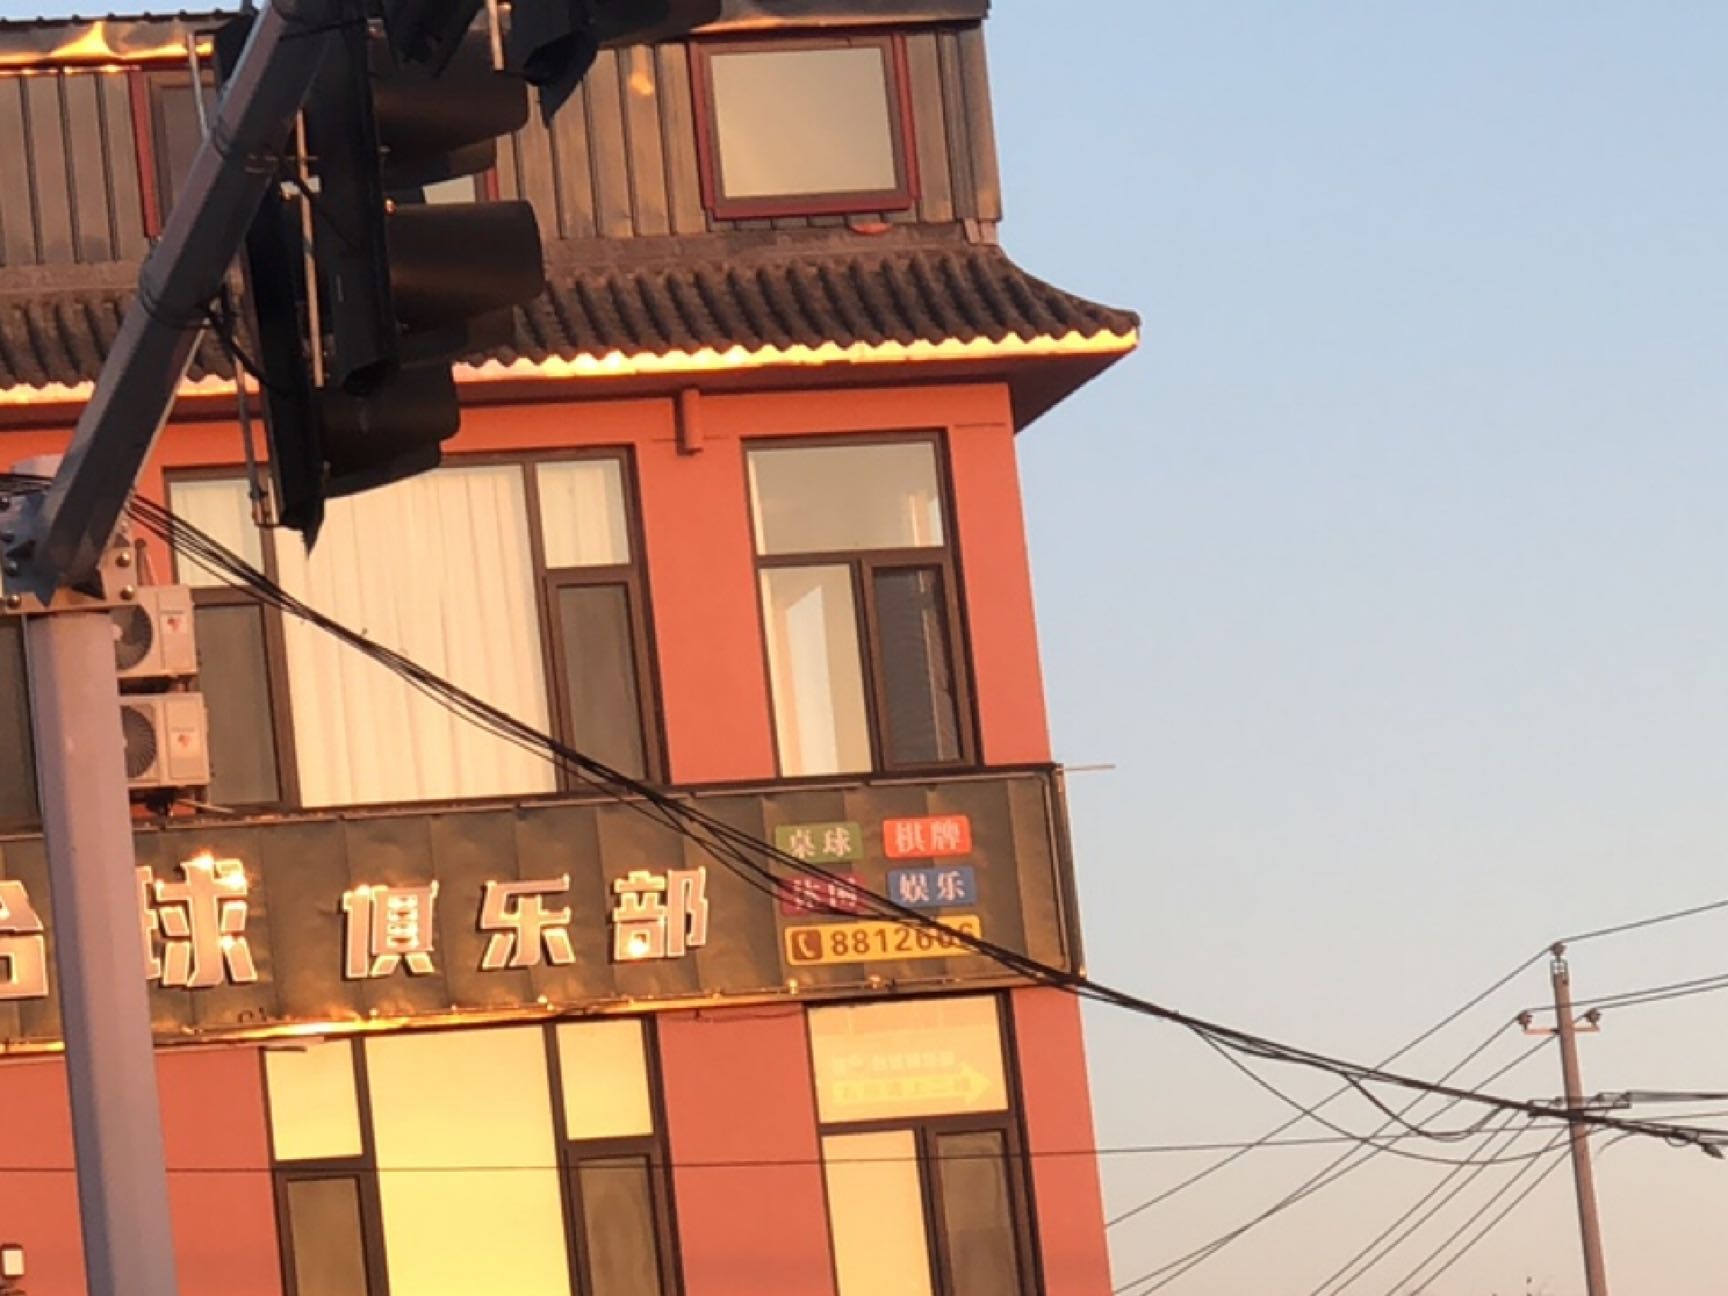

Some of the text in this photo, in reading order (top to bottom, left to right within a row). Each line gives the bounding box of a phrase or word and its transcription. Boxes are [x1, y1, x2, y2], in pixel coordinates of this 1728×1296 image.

[788, 826, 853, 859] 桌球
[896, 820, 961, 853] 棋牌
[899, 871, 966, 902] 娱乐
